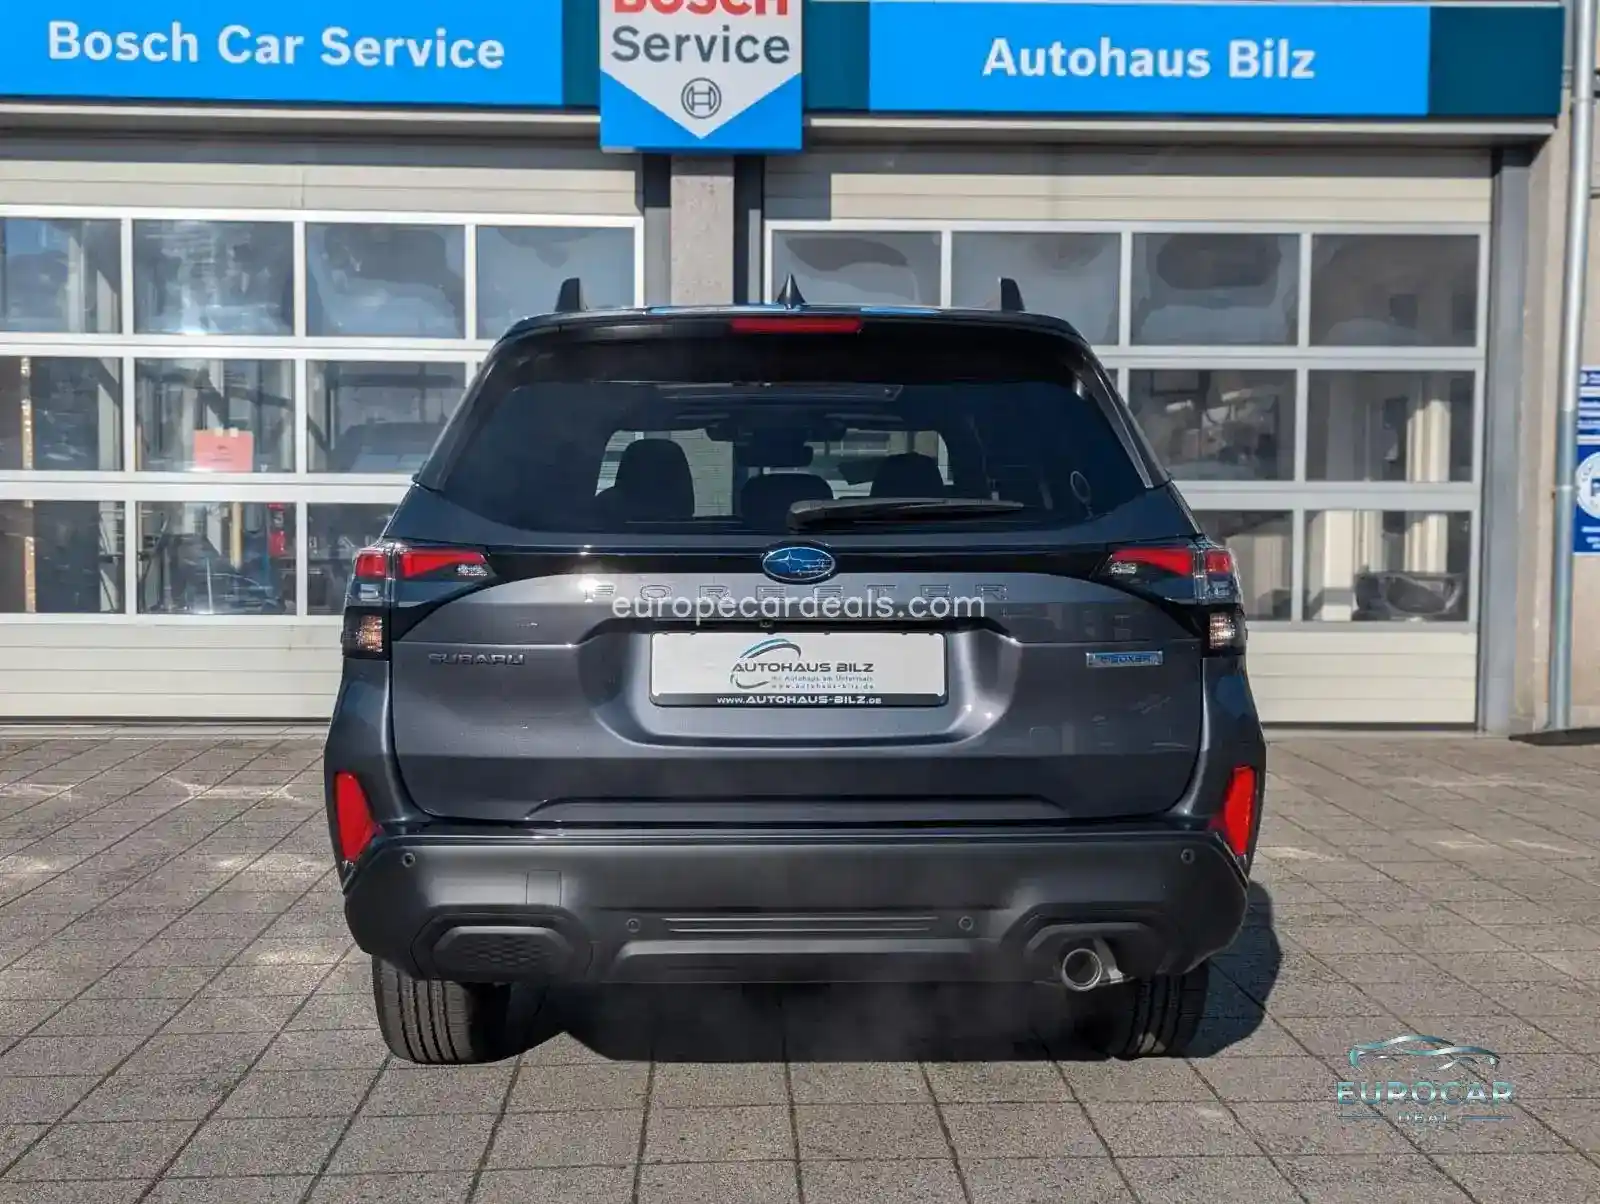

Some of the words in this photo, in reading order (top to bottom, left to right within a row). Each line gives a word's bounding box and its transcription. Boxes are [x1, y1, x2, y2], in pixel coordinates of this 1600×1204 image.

[48, 20, 199, 63] Bosch
[217, 25, 304, 66] Car
[320, 27, 505, 70] Service
[611, 24, 790, 64] Service
[982, 36, 1211, 78] Autohaus
[1228, 38, 1316, 79] Bilz
[428, 652, 526, 666] SUBARU
[732, 662, 832, 673] AUTOHAUS
[836, 662, 874, 673] BILZ
